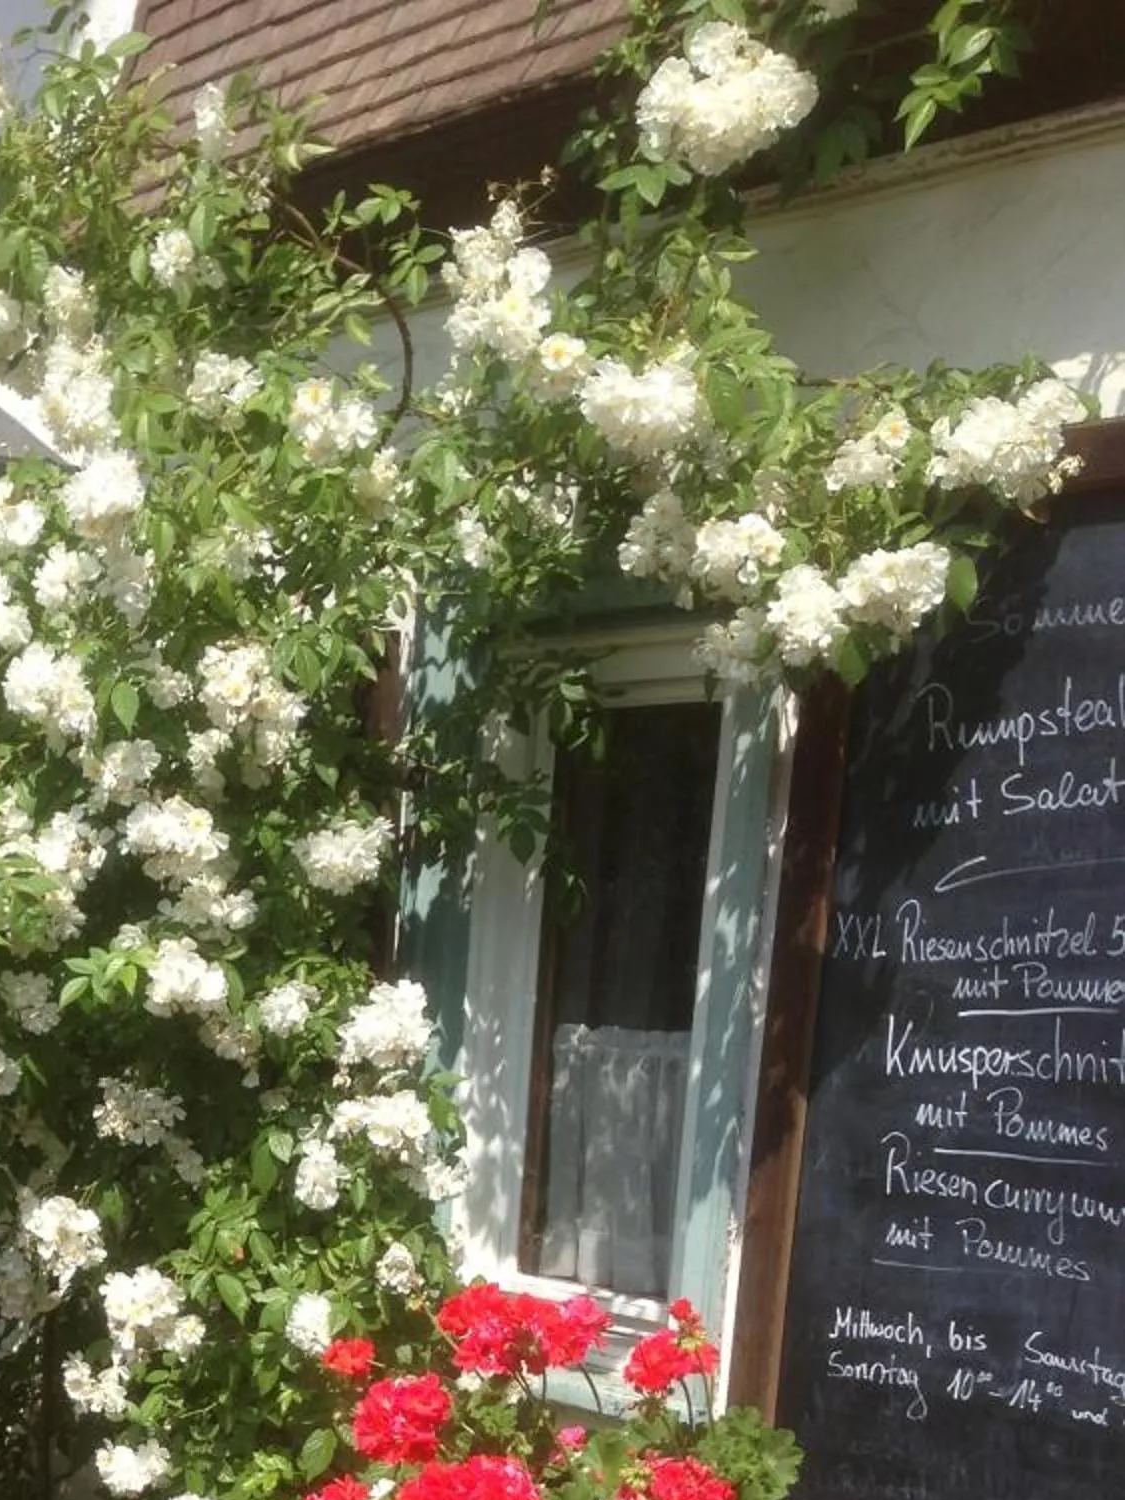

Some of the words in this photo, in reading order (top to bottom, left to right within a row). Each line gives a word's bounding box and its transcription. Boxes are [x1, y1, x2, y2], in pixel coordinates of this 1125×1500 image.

[913, 778, 983, 829] mit
[1000, 757, 1125, 816] Salat
[832, 910, 887, 960] XXL
[895, 899, 1097, 963] Riesenschnitzel
[952, 964, 1008, 999] mit
[915, 1090, 969, 1129] mit
[986, 1086, 1110, 1151] Pommes
[885, 1215, 934, 1250] mit
[954, 1217, 1091, 1281] Pommes
[948, 1320, 987, 1351] bis
[826, 1350, 928, 1420] Sonntag
